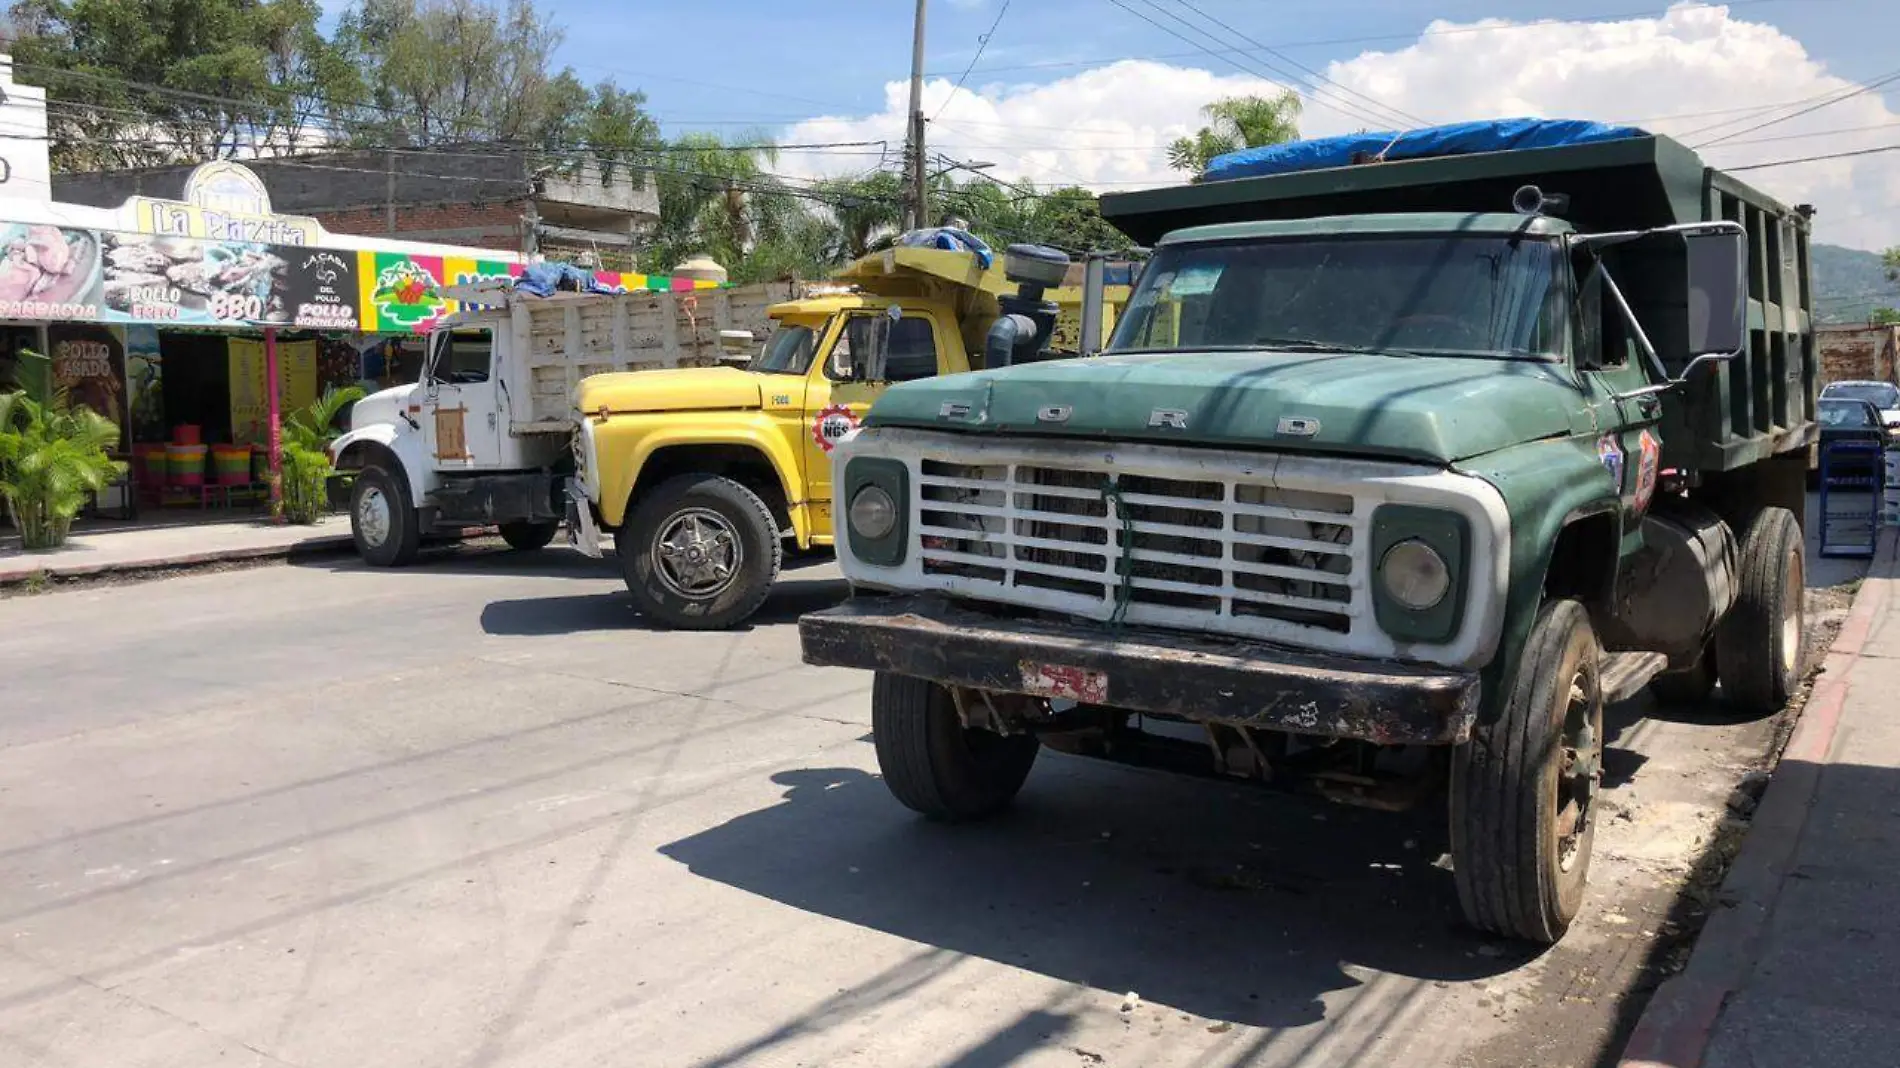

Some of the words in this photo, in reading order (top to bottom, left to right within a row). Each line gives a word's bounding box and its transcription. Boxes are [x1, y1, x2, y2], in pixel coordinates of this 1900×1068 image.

[320, 286, 335, 294] DEL
[315, 294, 341, 302] POLLO
[298, 303, 354, 318] POLLO
[295, 316, 358, 328] HORNEADO
[940, 401, 1322, 438] FORD
